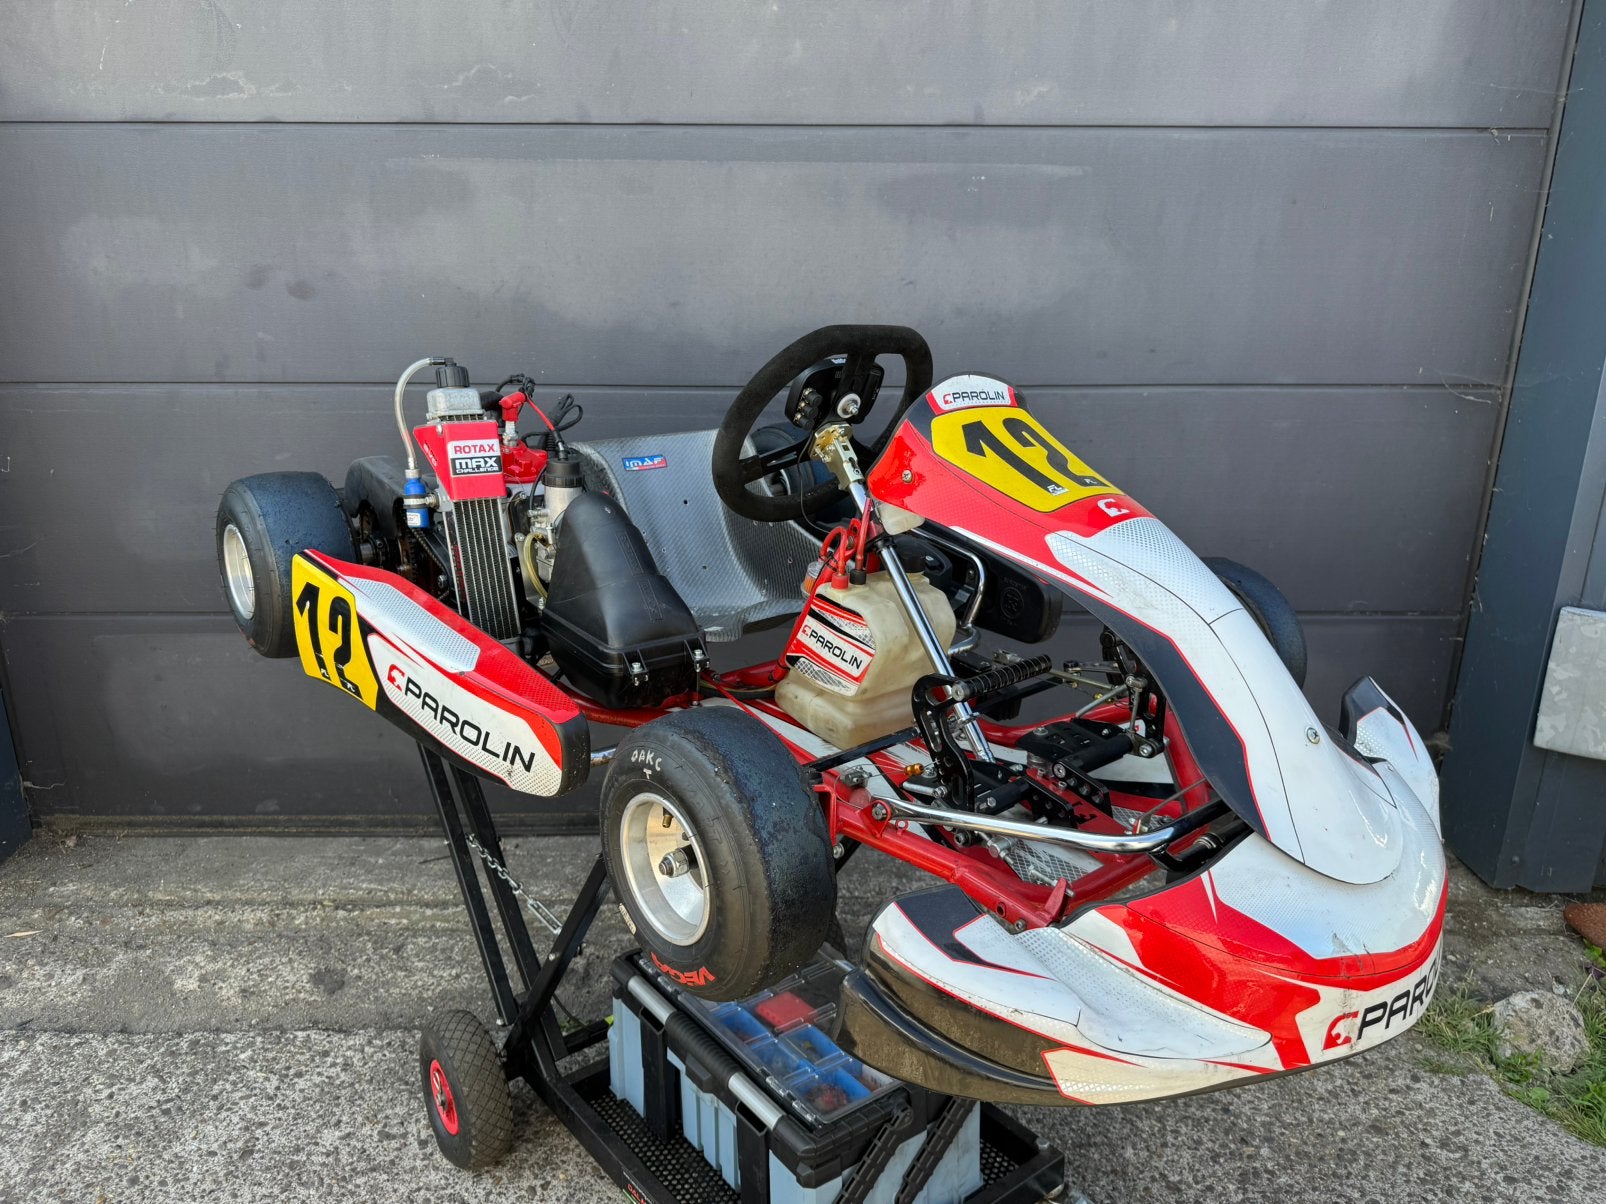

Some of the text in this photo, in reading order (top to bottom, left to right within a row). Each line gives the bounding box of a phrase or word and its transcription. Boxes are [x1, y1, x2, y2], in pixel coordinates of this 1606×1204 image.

[952, 390, 1006, 403] PAROLIN
[453, 443, 496, 455] ROTAX
[455, 456, 498, 469] MAX
[961, 417, 1111, 496] 12
[456, 466, 499, 474] CHALLENGE
[295, 582, 364, 701] 12
[808, 629, 863, 670] PAROLIN
[404, 676, 536, 773] PAROLIN
[651, 951, 716, 987] VEGA
